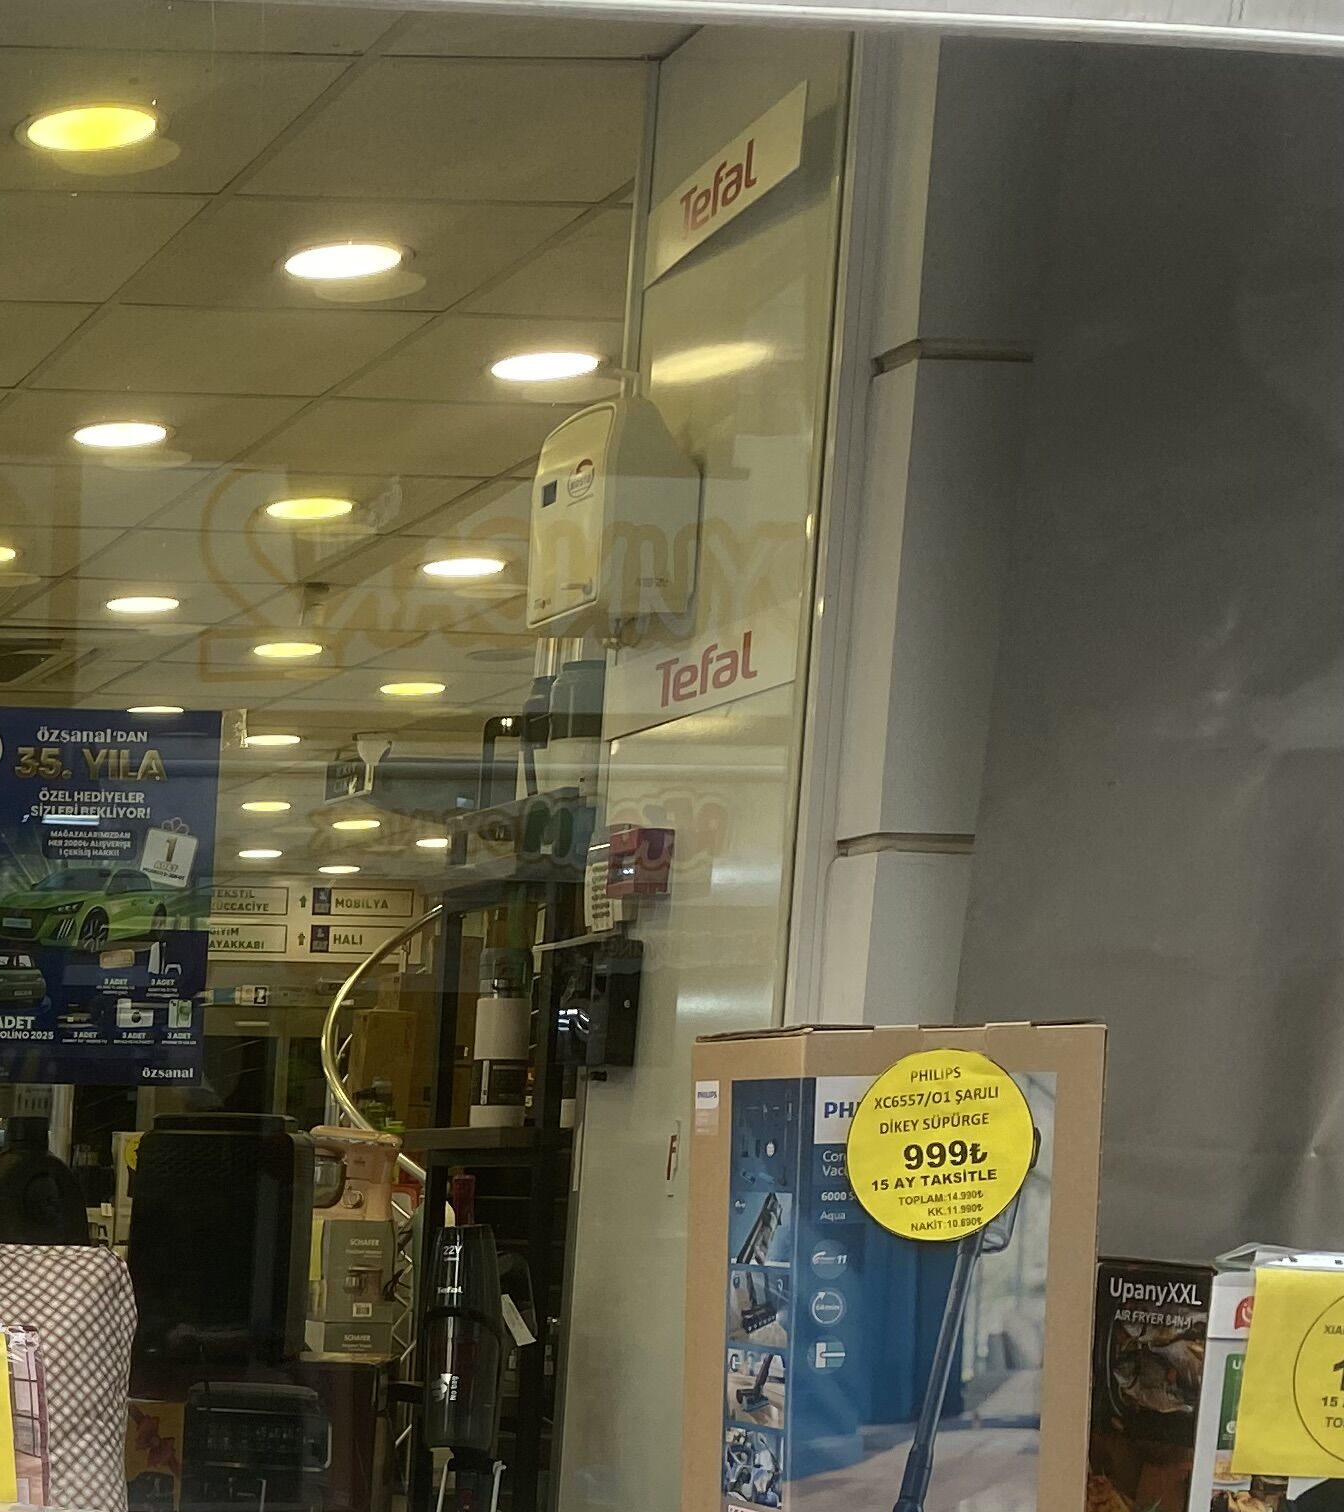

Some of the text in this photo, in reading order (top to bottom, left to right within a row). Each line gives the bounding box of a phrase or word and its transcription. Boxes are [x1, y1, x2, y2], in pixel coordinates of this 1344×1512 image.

[679, 138, 757, 240] Tefal
[655, 630, 757, 709] Tefal
[15, 747, 168, 781] 35. YILA
[39, 787, 145, 805] ÖZEL HEDİYELER
[335, 897, 389, 910] MOBİLYA
[333, 933, 363, 945] HALI
[30, 1030, 54, 1040] 2025
[142, 1066, 194, 1079] özsanal
[910, 1066, 961, 1083] PHILIPS
[879, 1112, 990, 1135] DİKEY SÜPÜRGE
[903, 1139, 988, 1171] 999₺
[871, 1168, 998, 1192] 15 AY TAKSİTLE
[821, 1191, 847, 1201] 6000
[820, 1210, 846, 1221] Aqua
[1109, 1277, 1203, 1306] UpanyXXL
[1114, 1309, 1163, 1327] AIR FRYER
[1322, 1396, 1338, 1408] 15
